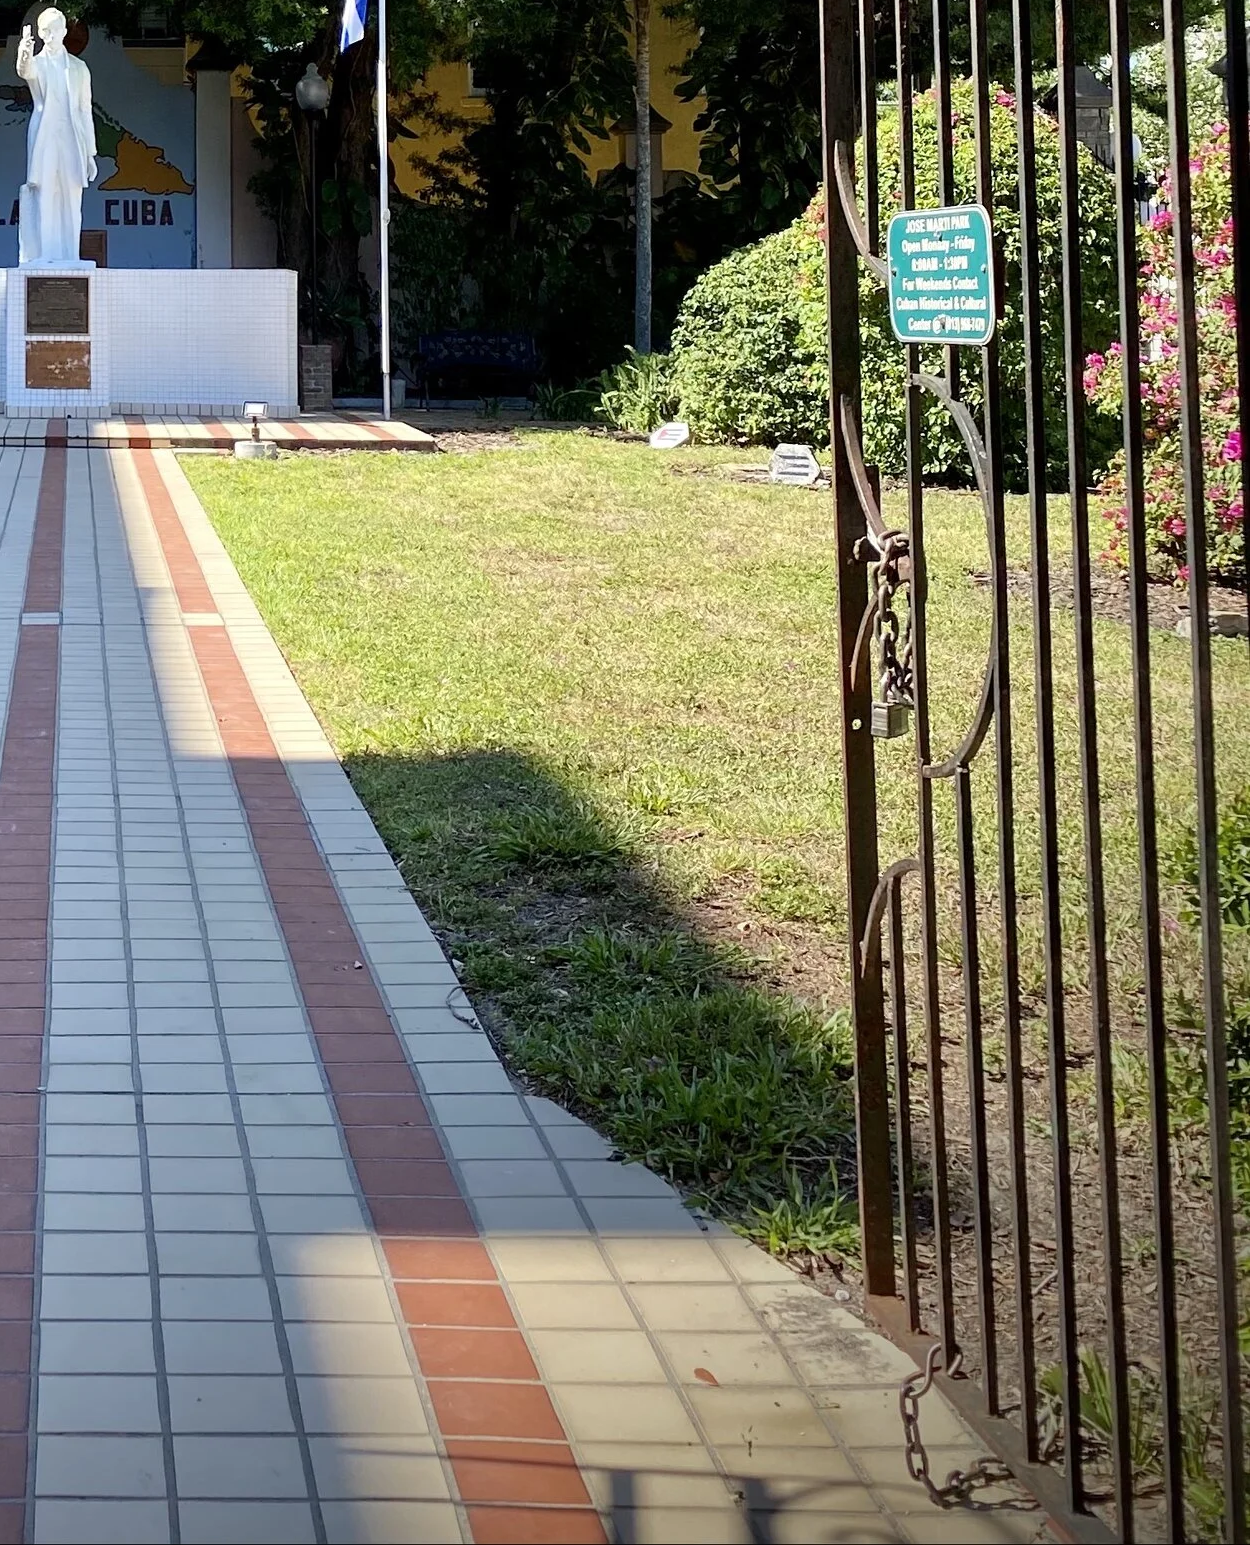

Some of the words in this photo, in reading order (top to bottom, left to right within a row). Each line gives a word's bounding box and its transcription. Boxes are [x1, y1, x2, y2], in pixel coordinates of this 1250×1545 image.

[105, 199, 174, 226] CUBA
[905, 219, 926, 234] JOSE
[926, 216, 950, 232] MARTI
[950, 215, 970, 230] PARK
[901, 239, 921, 256] Open
[921, 238, 950, 254] Monday
[954, 235, 975, 253] Friday
[902, 277, 915, 291] For
[915, 276, 952, 291] Weekends
[952, 276, 978, 290] Contact
[896, 296, 918, 311] Cuban
[919, 296, 953, 310] Historical
[953, 296, 960, 310] &
[960, 296, 986, 310] Cultural
[908, 317, 931, 331] Center
